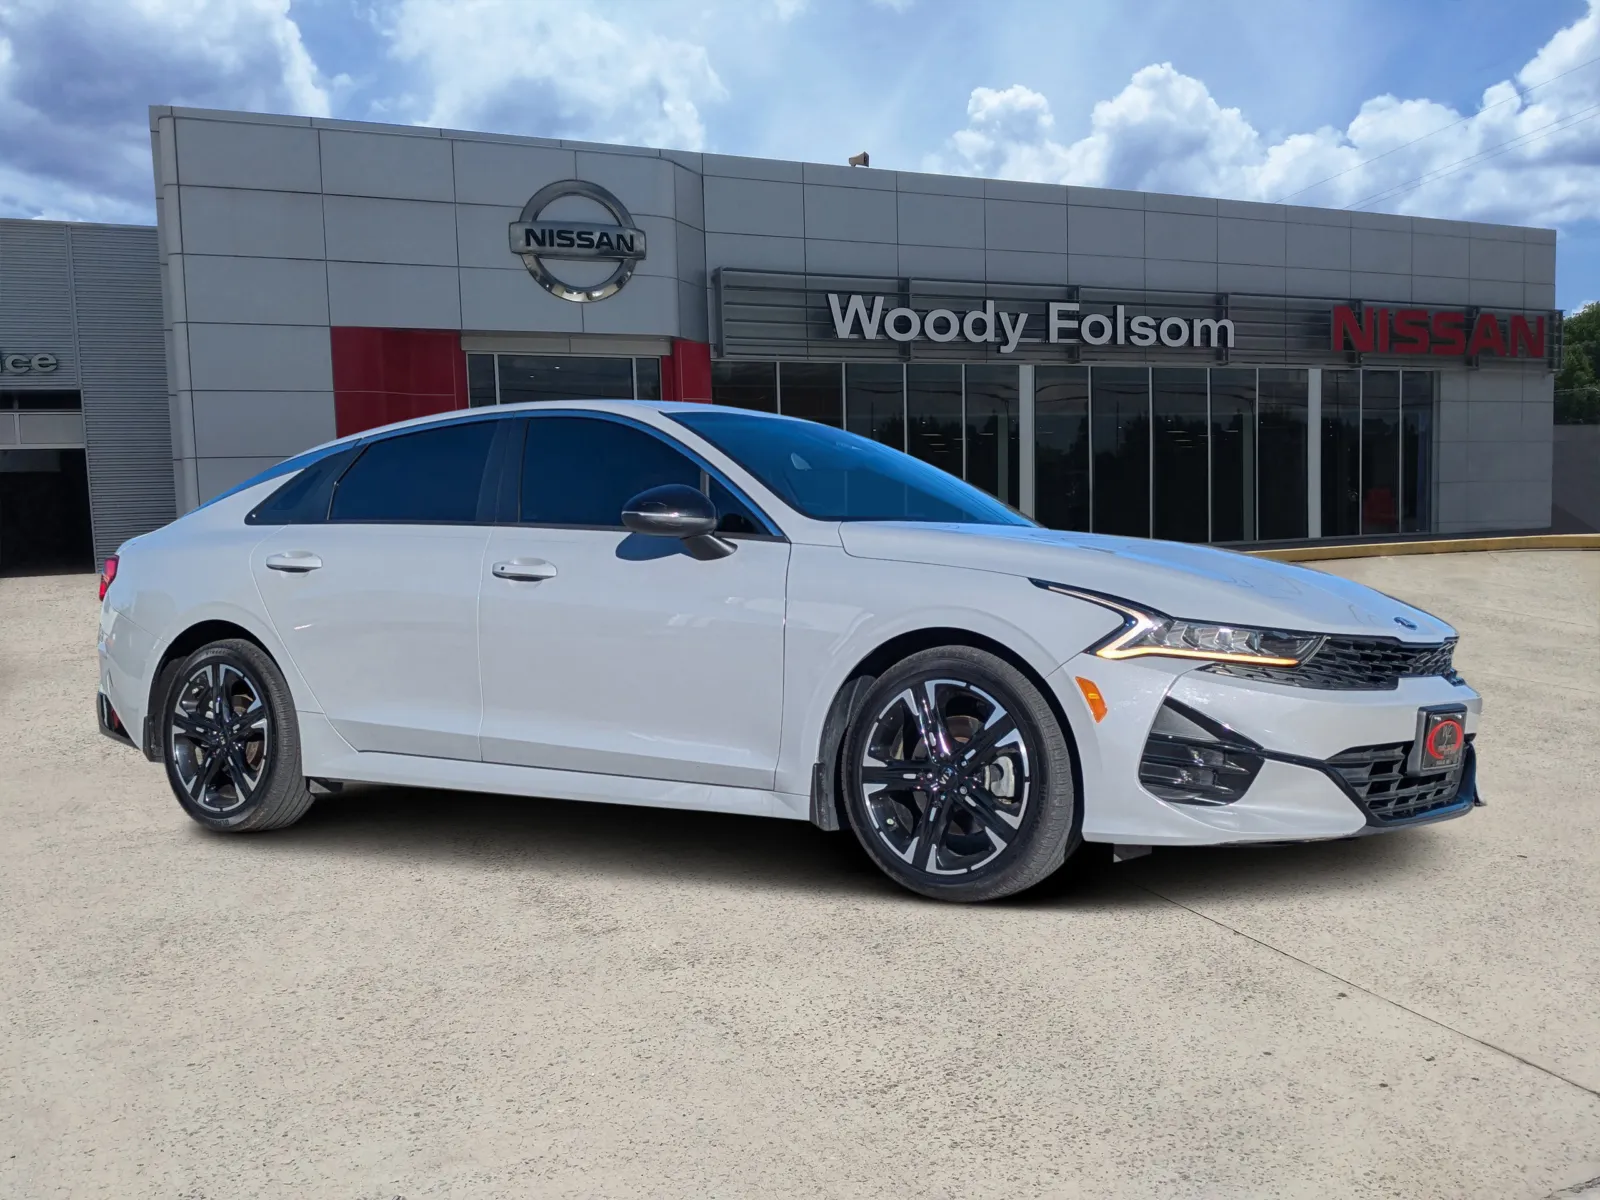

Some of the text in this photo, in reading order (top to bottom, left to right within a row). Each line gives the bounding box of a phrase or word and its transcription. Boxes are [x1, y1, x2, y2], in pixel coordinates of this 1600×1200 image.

[525, 228, 635, 252] NISSAN
[827, 293, 1235, 353] Woody Folsom
[1333, 305, 1545, 358] NISSAN
[0, 352, 57, 373] ce
